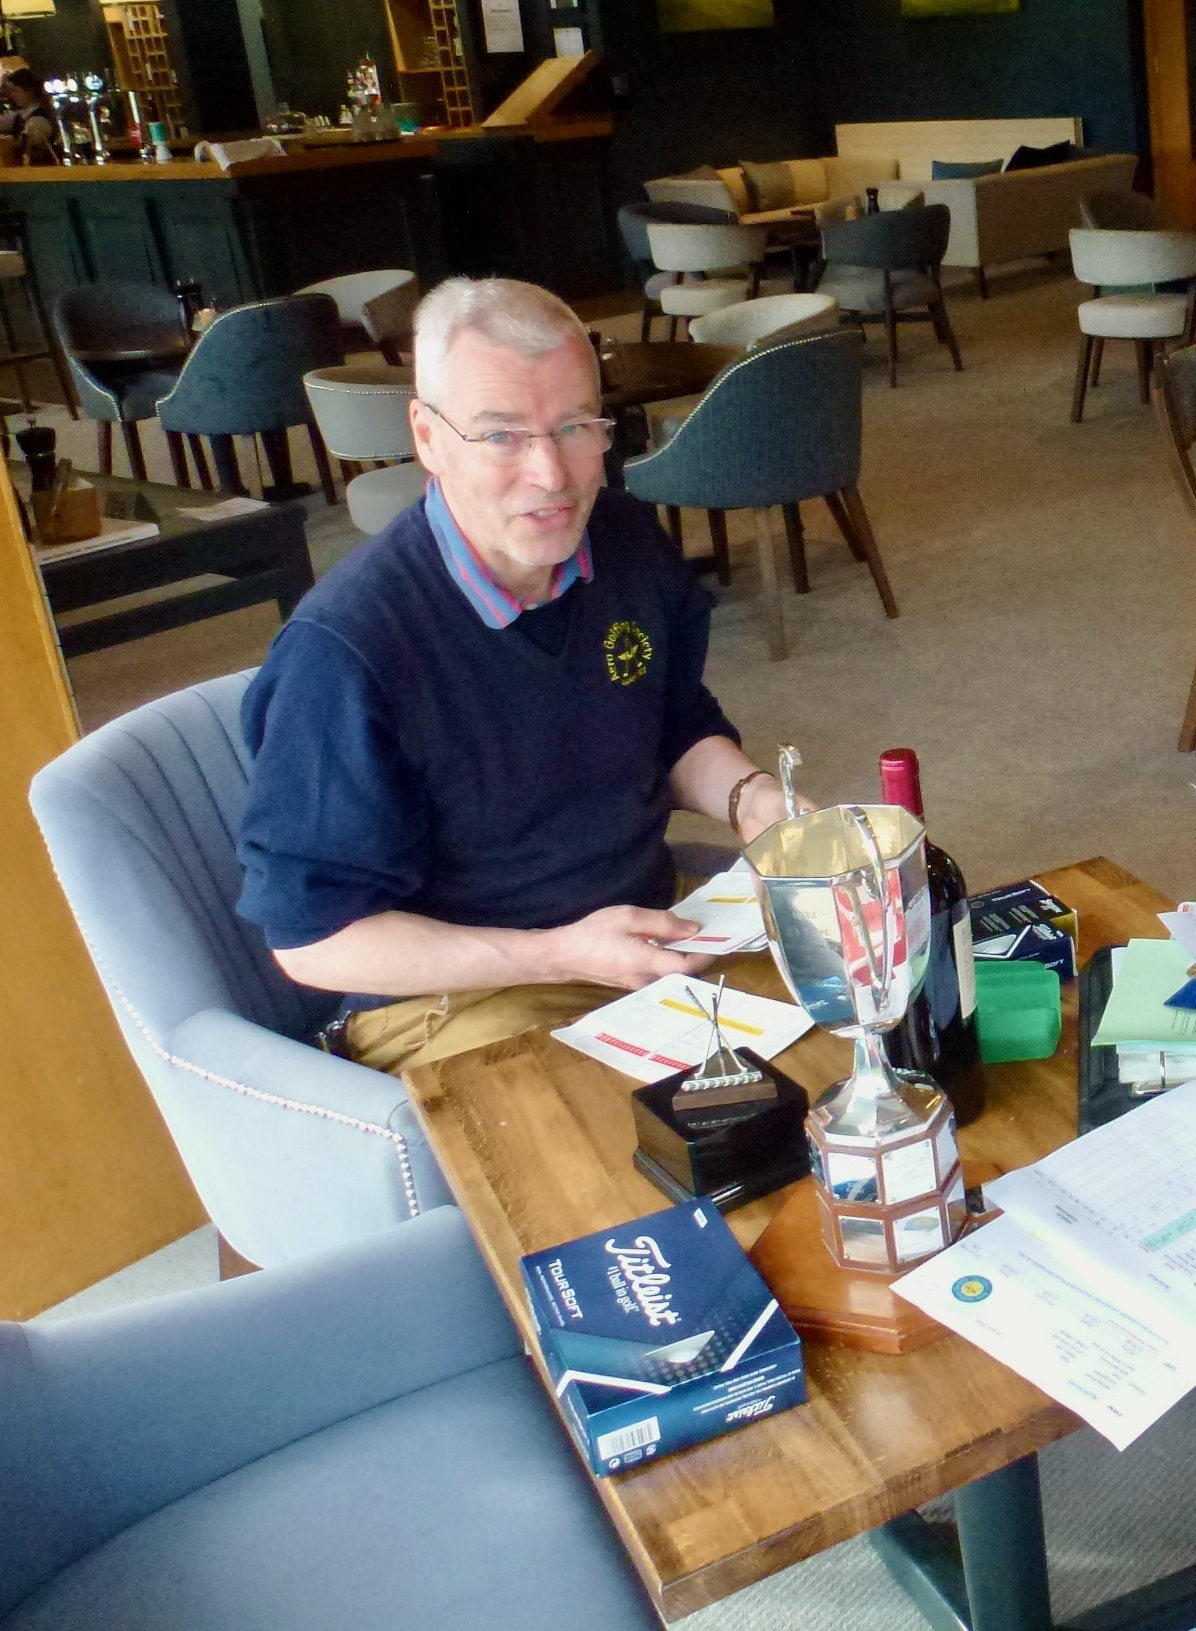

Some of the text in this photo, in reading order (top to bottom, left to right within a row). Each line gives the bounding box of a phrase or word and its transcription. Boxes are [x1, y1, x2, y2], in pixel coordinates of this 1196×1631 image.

[605, 1236, 680, 1326] Titleist
[609, 1270, 625, 1290] ball
[616, 1286, 628, 1298] in
[725, 1395, 776, 1423] Titleist
